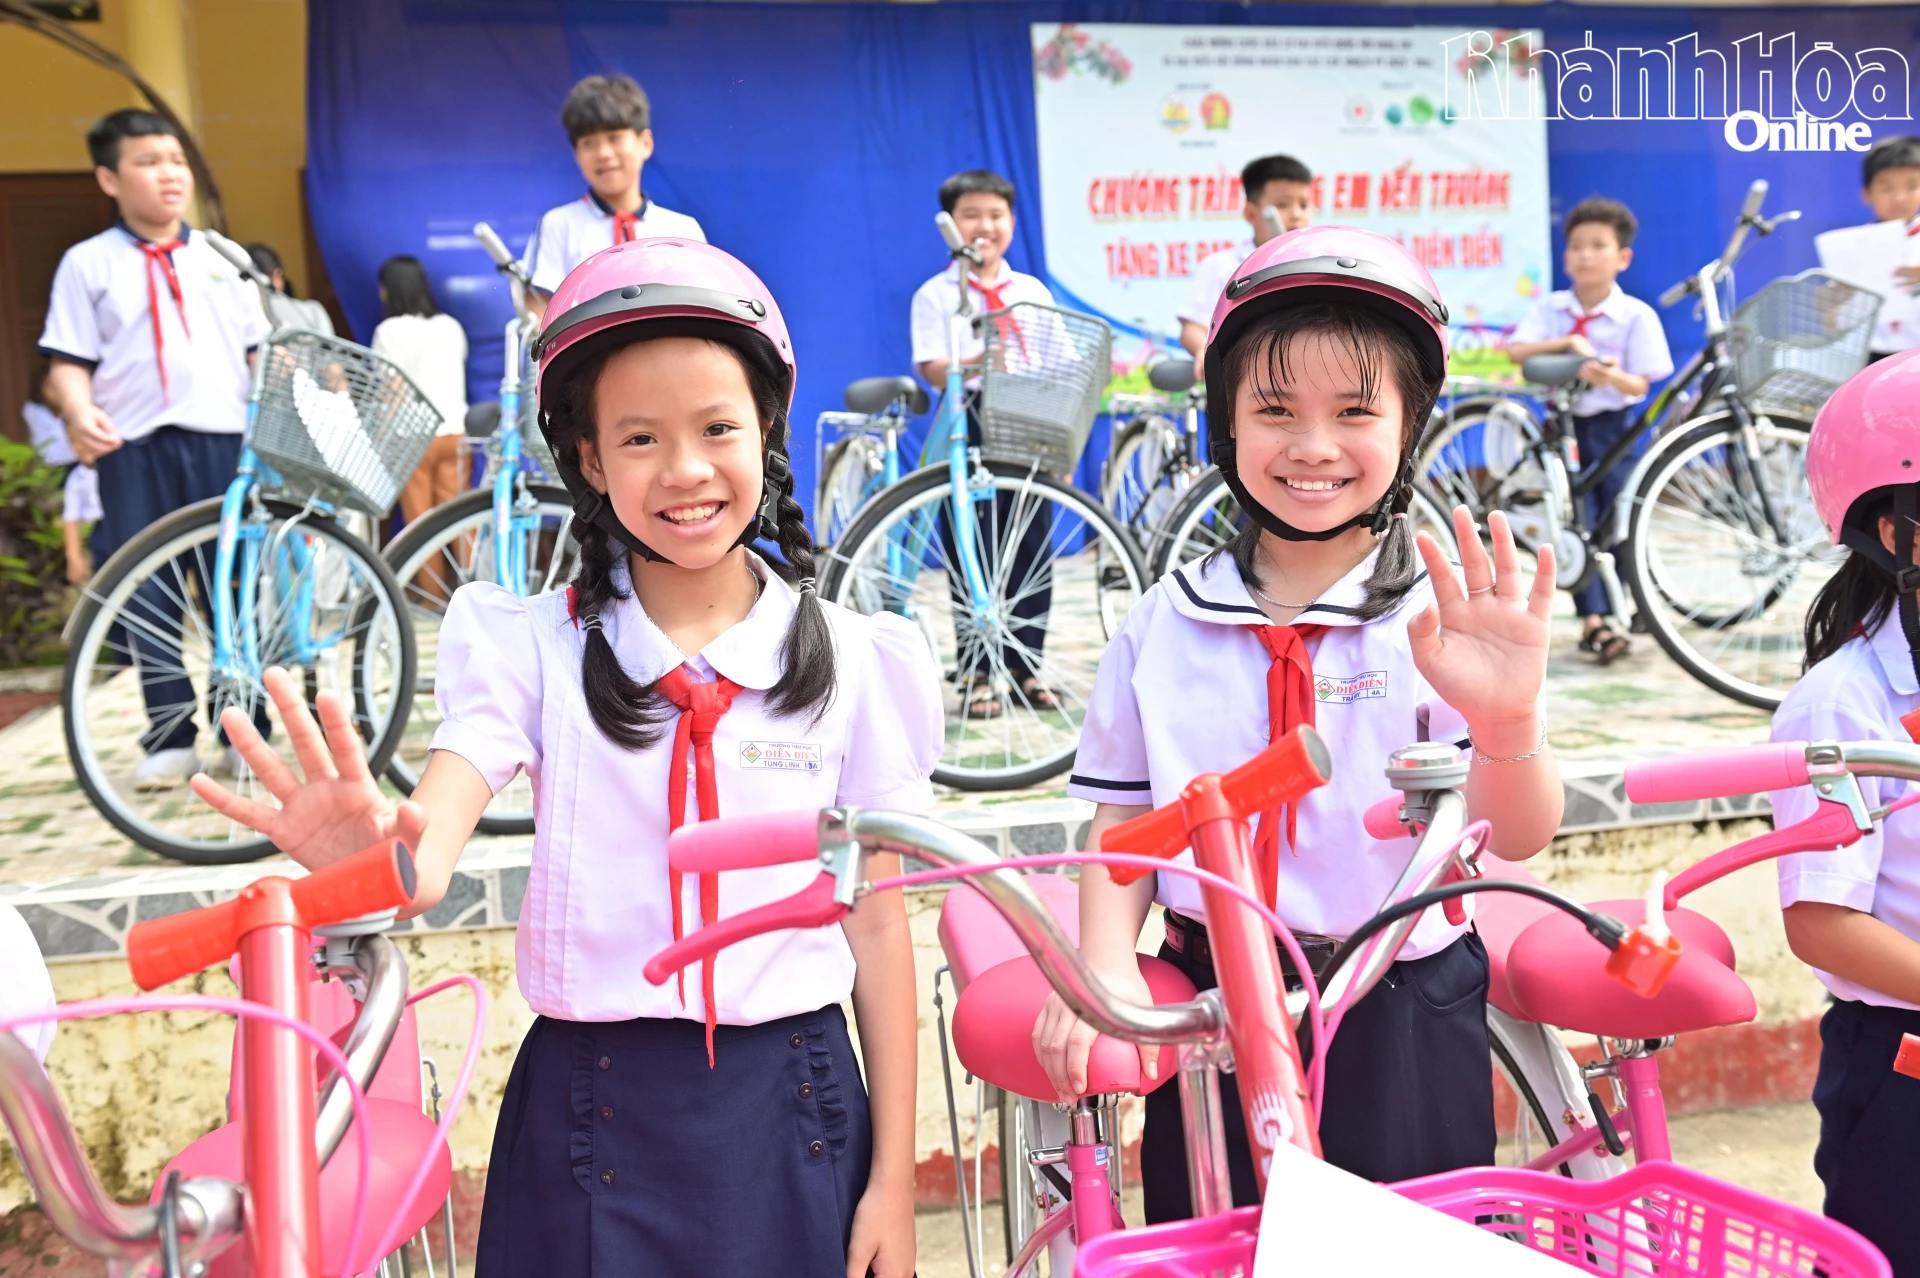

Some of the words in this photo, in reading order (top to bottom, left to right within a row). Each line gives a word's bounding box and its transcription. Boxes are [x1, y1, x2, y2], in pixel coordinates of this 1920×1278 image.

[1189, 165, 1243, 217] TRÌN
[1165, 241, 1188, 276] XE
[765, 748, 791, 758] DIÊN
[784, 761, 800, 769] LINH
